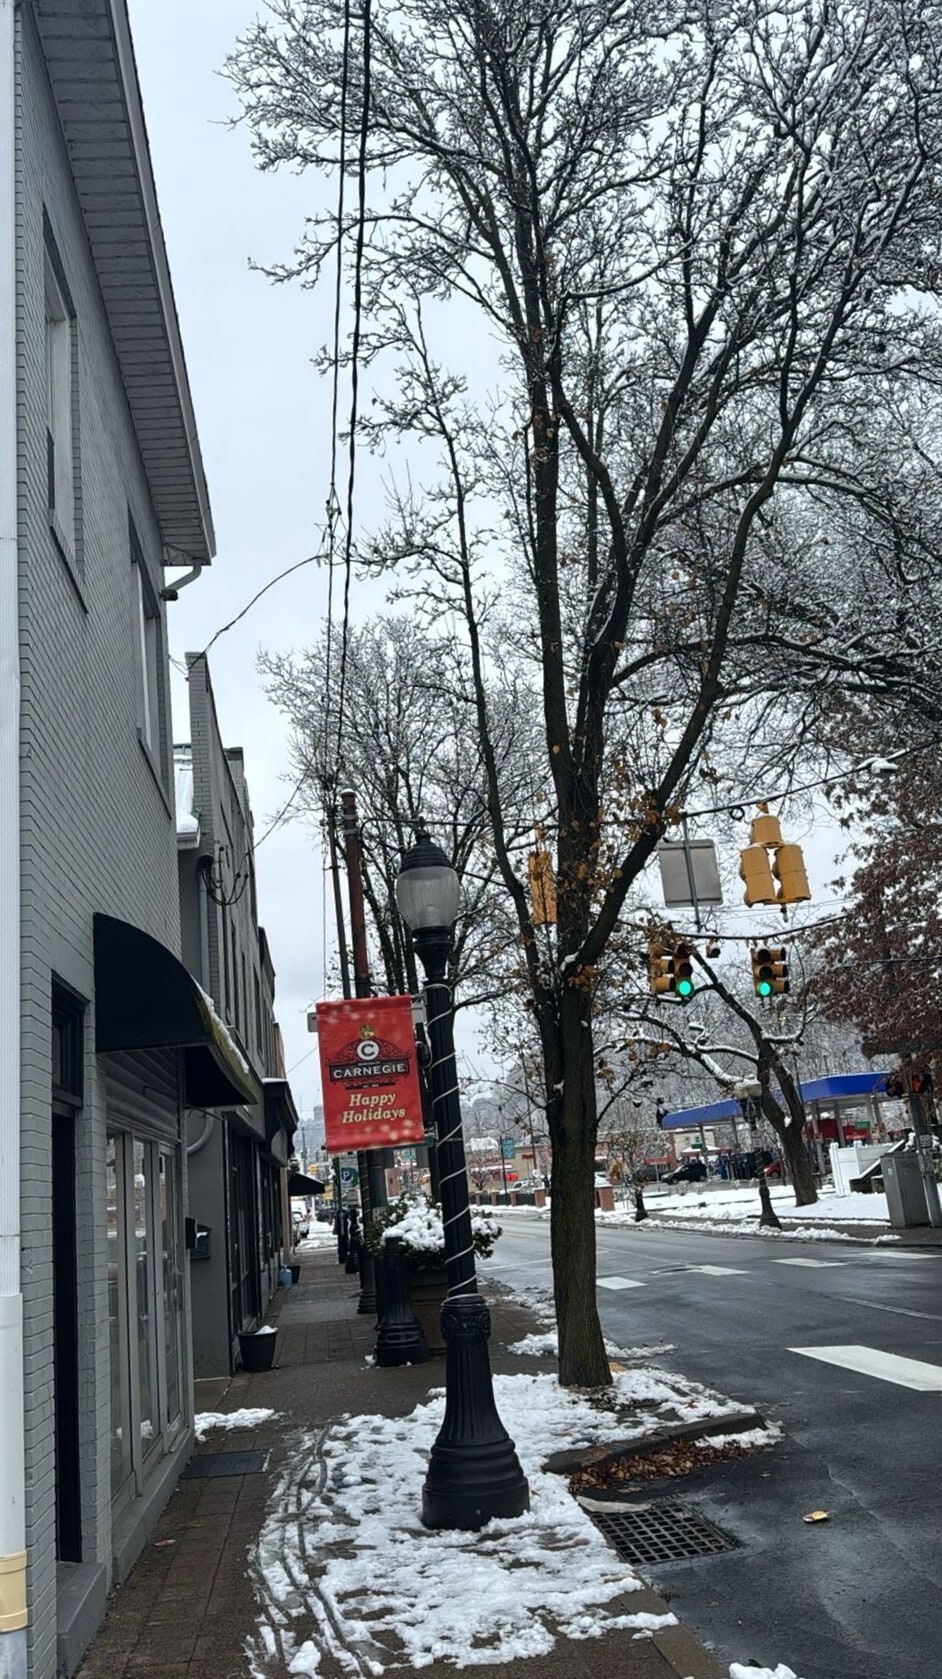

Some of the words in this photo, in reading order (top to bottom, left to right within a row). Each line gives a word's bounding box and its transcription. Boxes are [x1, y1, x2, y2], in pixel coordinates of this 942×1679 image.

[361, 1043, 375, 1056] C
[333, 1063, 405, 1079] CARNEGIE
[349, 1093, 396, 1107] Happy
[342, 1107, 406, 1124] Holidays
[343, 1172, 350, 1181] P
